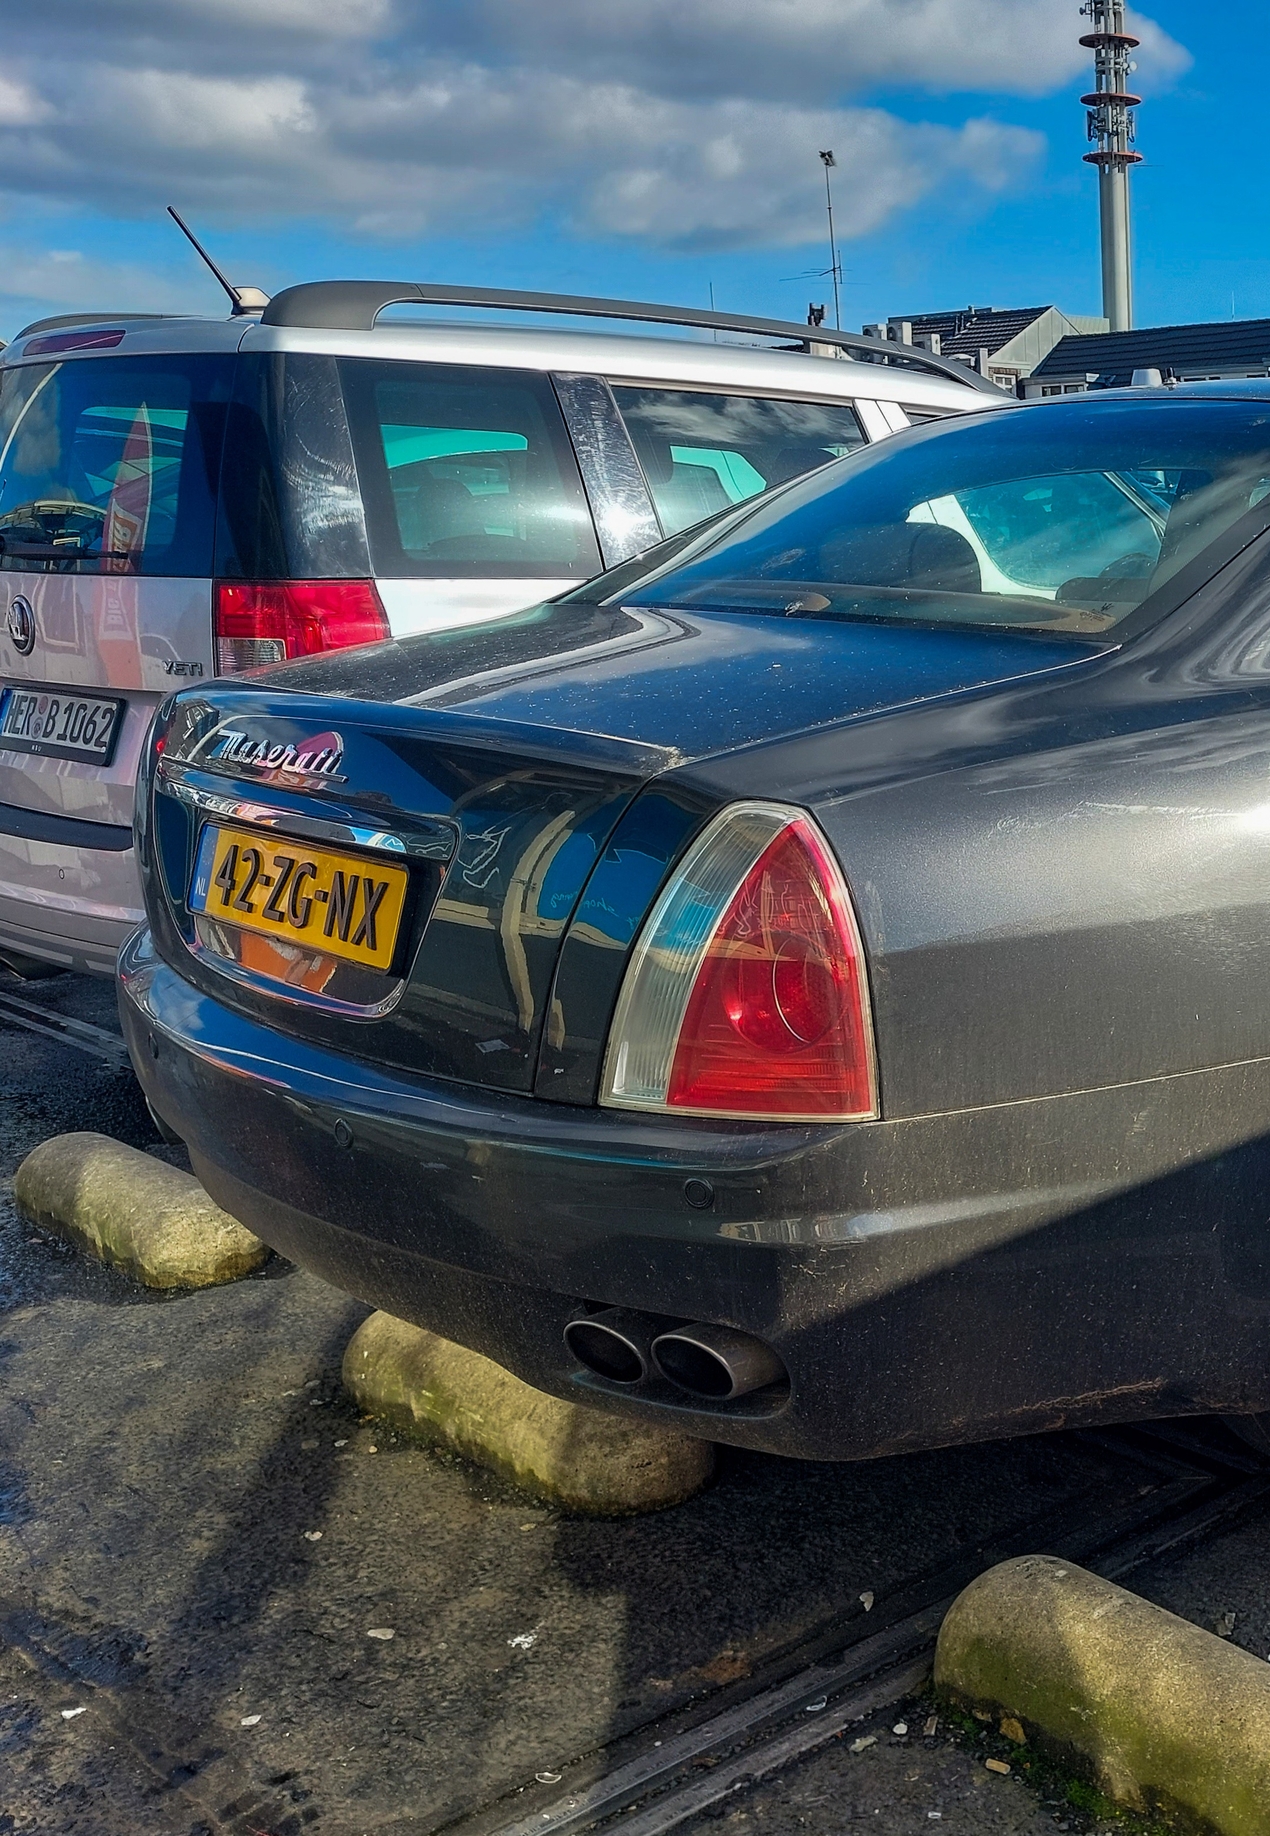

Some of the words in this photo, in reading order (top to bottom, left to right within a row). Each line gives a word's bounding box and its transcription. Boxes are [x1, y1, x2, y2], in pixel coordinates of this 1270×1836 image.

[161, 660, 204, 676] YETI
[3, 694, 38, 736] HER
[206, 728, 348, 782] Maserati
[195, 876, 207, 897] NL
[214, 844, 389, 951] 42-ZG-NX
